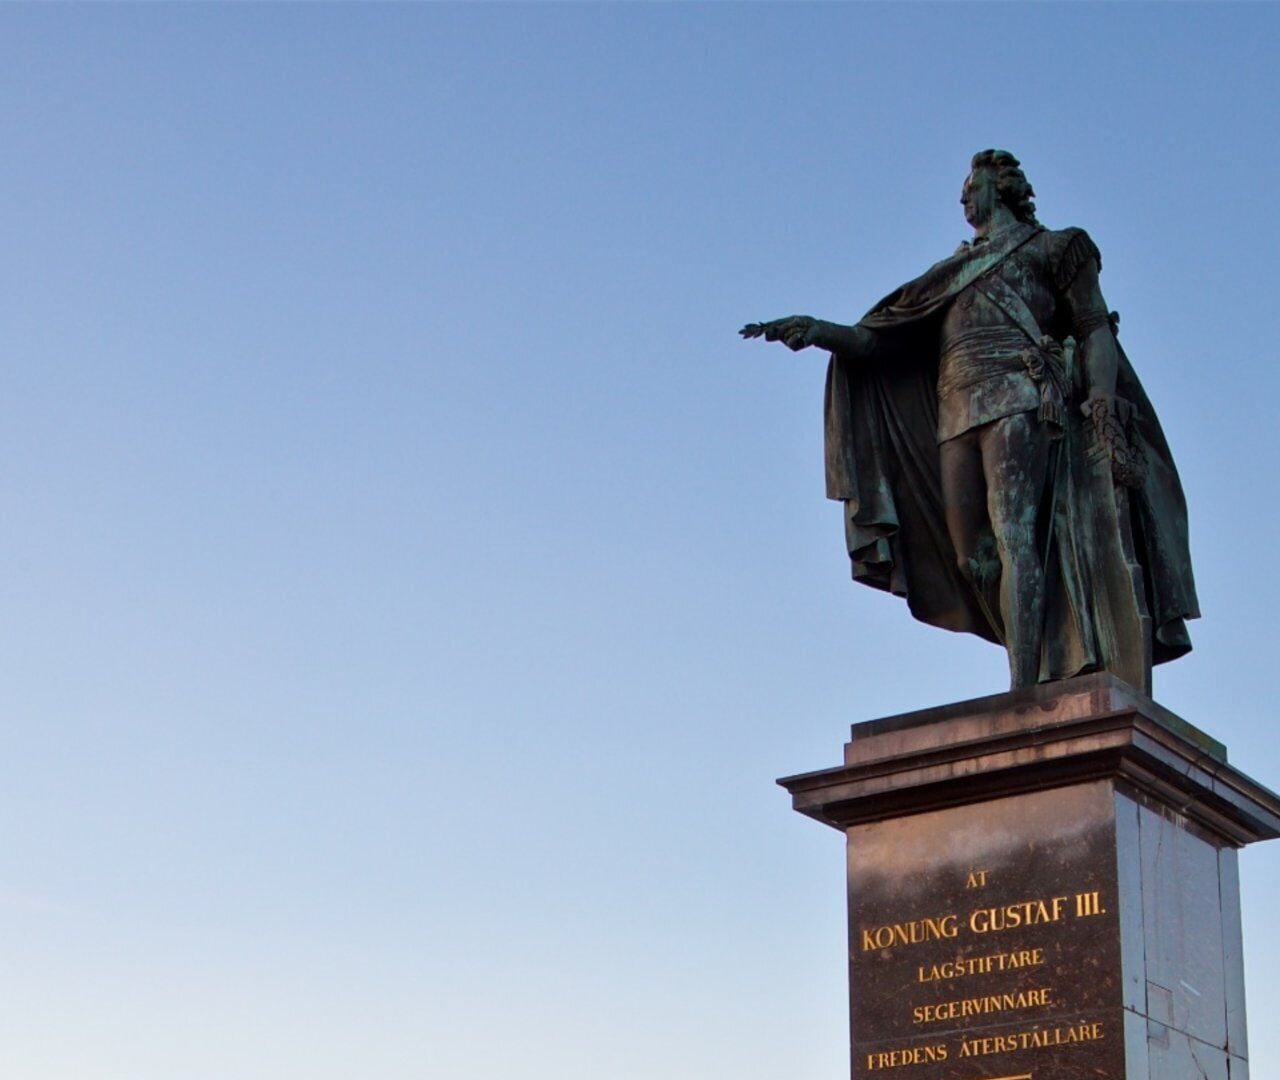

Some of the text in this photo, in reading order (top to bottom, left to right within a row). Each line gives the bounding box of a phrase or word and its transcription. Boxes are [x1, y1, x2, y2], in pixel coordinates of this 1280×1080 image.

[966, 870, 990, 889] AT
[862, 892, 1107, 951] KONUNG GUSTAF III.
[918, 949, 1044, 982] LAGSTIFTARE
[913, 988, 1052, 1023] SEGERVINNARE
[867, 1044, 948, 1070] FREDENS
